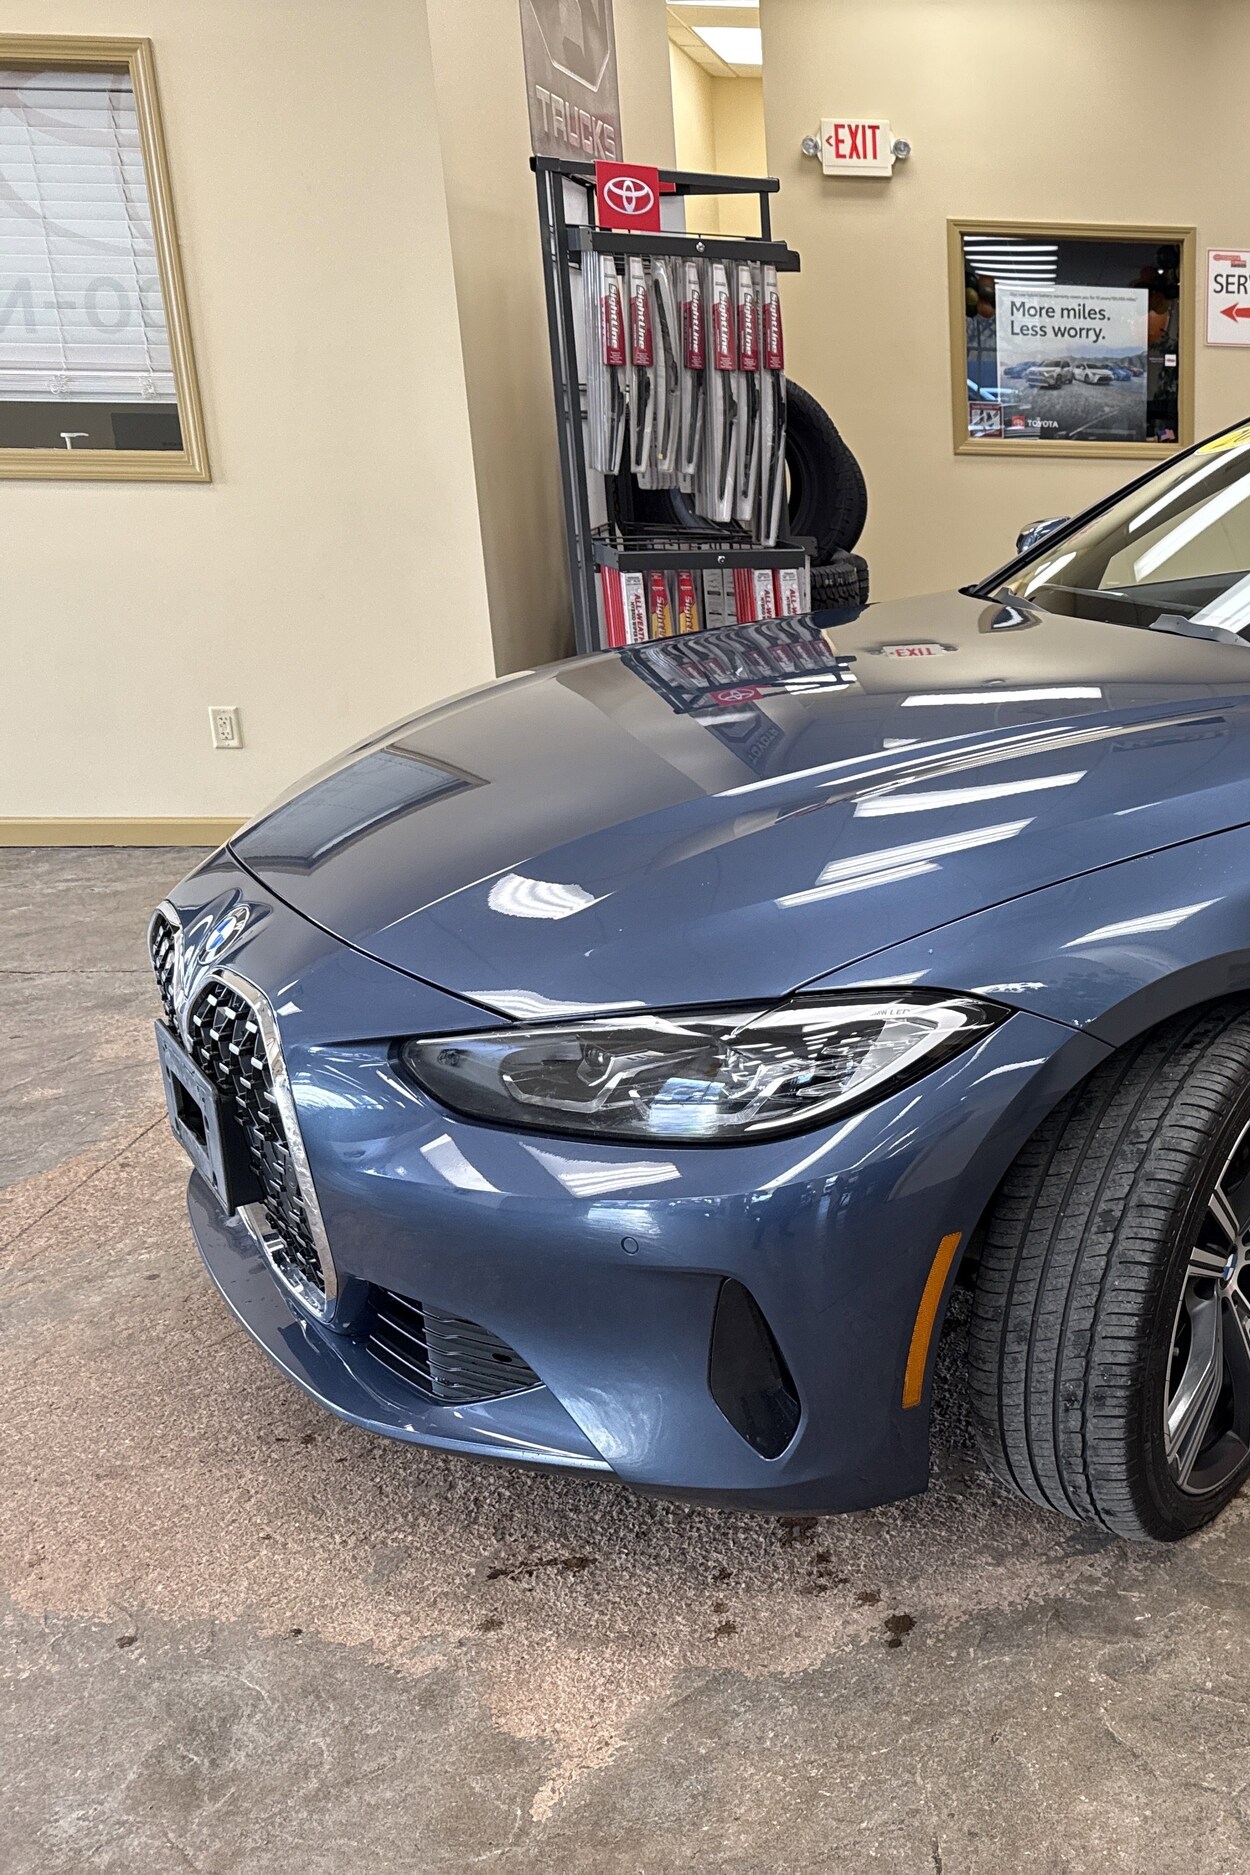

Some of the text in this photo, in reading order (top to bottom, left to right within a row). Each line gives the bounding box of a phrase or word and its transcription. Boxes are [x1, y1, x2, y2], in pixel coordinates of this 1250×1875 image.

[535, 84, 617, 161] TRUCKS
[833, 123, 880, 160] EXIT
[1010, 301, 1111, 321] More miles.
[1010, 320, 1106, 343] Less worry.
[1027, 420, 1059, 428] TOYOTA
